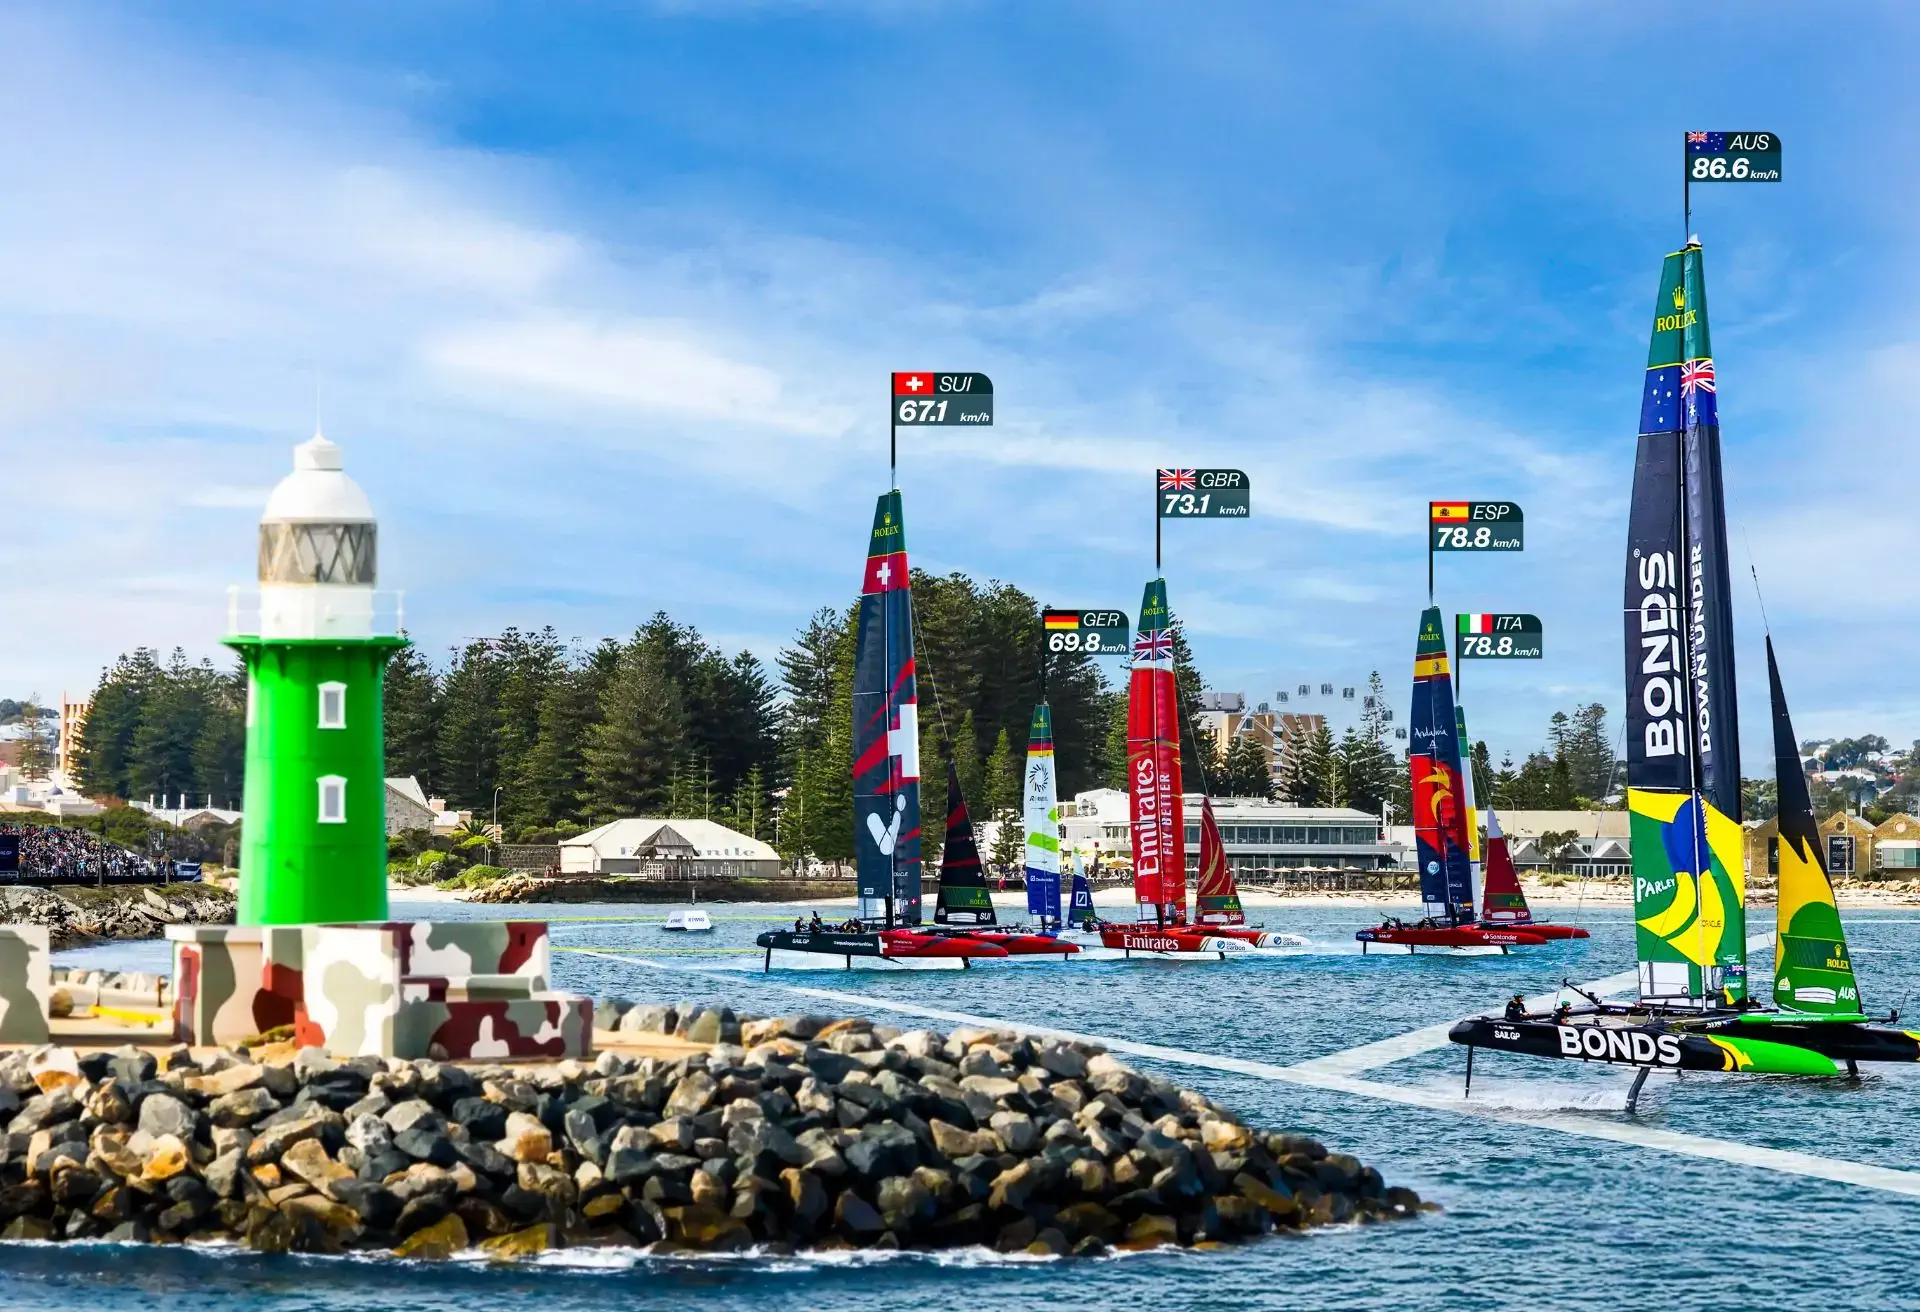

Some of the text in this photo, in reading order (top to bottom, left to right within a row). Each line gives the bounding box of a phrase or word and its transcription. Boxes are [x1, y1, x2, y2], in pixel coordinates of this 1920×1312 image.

[1657, 309, 1697, 332] ROLEX
[874, 525, 899, 538] ROLEX
[1143, 606, 1165, 616] ROLEX
[1420, 632, 1440, 641] ROLEX
[1639, 551, 1676, 758] BONDS
[1692, 542, 1711, 753] DOWN UNDER
[1135, 758, 1159, 878] Emirates
[1160, 773, 1174, 856] FLY BETTER
[1636, 876, 1676, 903] PARLEY
[980, 912, 991, 920] SUI
[1123, 934, 1179, 950] Emirates
[1490, 933, 1517, 941] Santander
[1826, 958, 1850, 969] ROLEX
[1838, 986, 1857, 1000] AUS
[1557, 1025, 1682, 1064] BONDS
